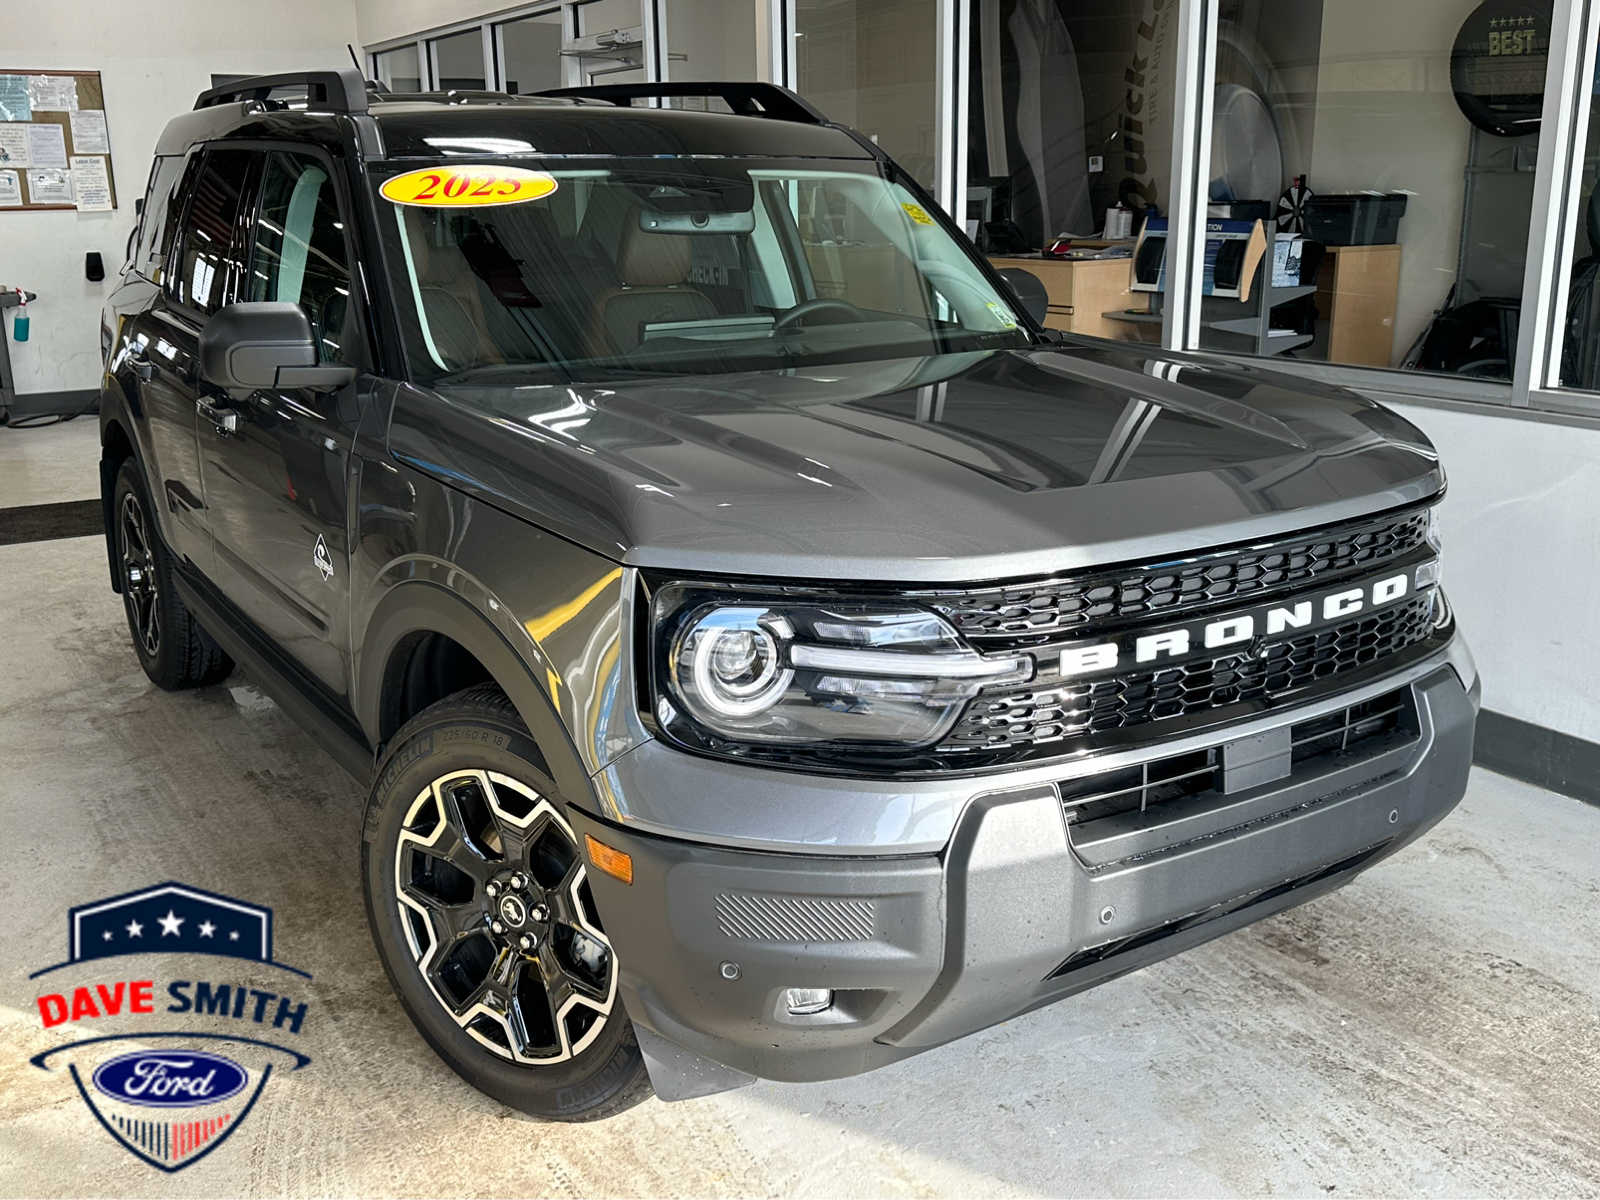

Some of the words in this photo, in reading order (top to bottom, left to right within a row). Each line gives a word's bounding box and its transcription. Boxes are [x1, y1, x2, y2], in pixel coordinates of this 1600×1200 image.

[1488, 29, 1537, 56] BEST
[412, 173, 522, 201] 2025
[1059, 573, 1409, 677] BRONCO
